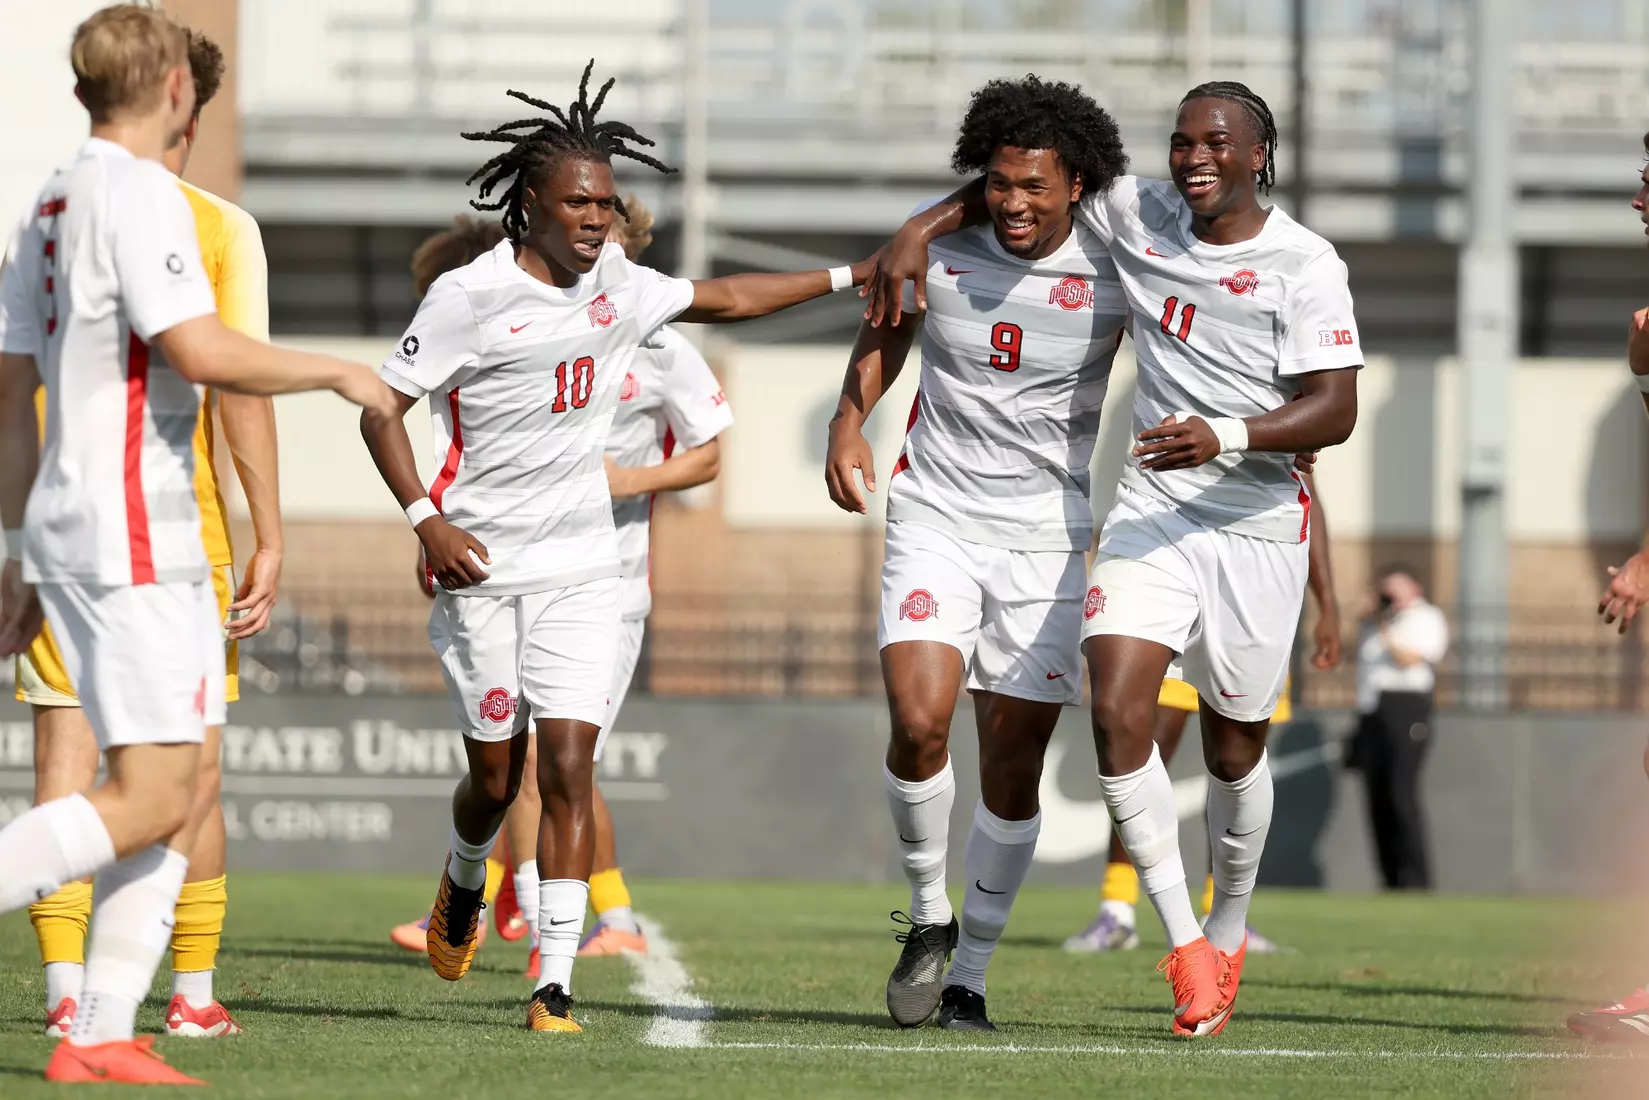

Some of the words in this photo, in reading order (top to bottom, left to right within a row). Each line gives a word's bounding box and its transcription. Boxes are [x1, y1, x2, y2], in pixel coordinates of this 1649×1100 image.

[1048, 285, 1069, 305] OHIO
[1069, 284, 1096, 309] STATE
[1159, 296, 1197, 342] 11
[395, 351, 416, 367] CHASE
[989, 321, 1023, 372] 9
[551, 355, 594, 413] 10
[915, 596, 940, 620] STATE
[479, 699, 496, 719] OHIO
[494, 697, 518, 715] STATE
[221, 725, 345, 773] TATE
[250, 800, 393, 842] CENTER
